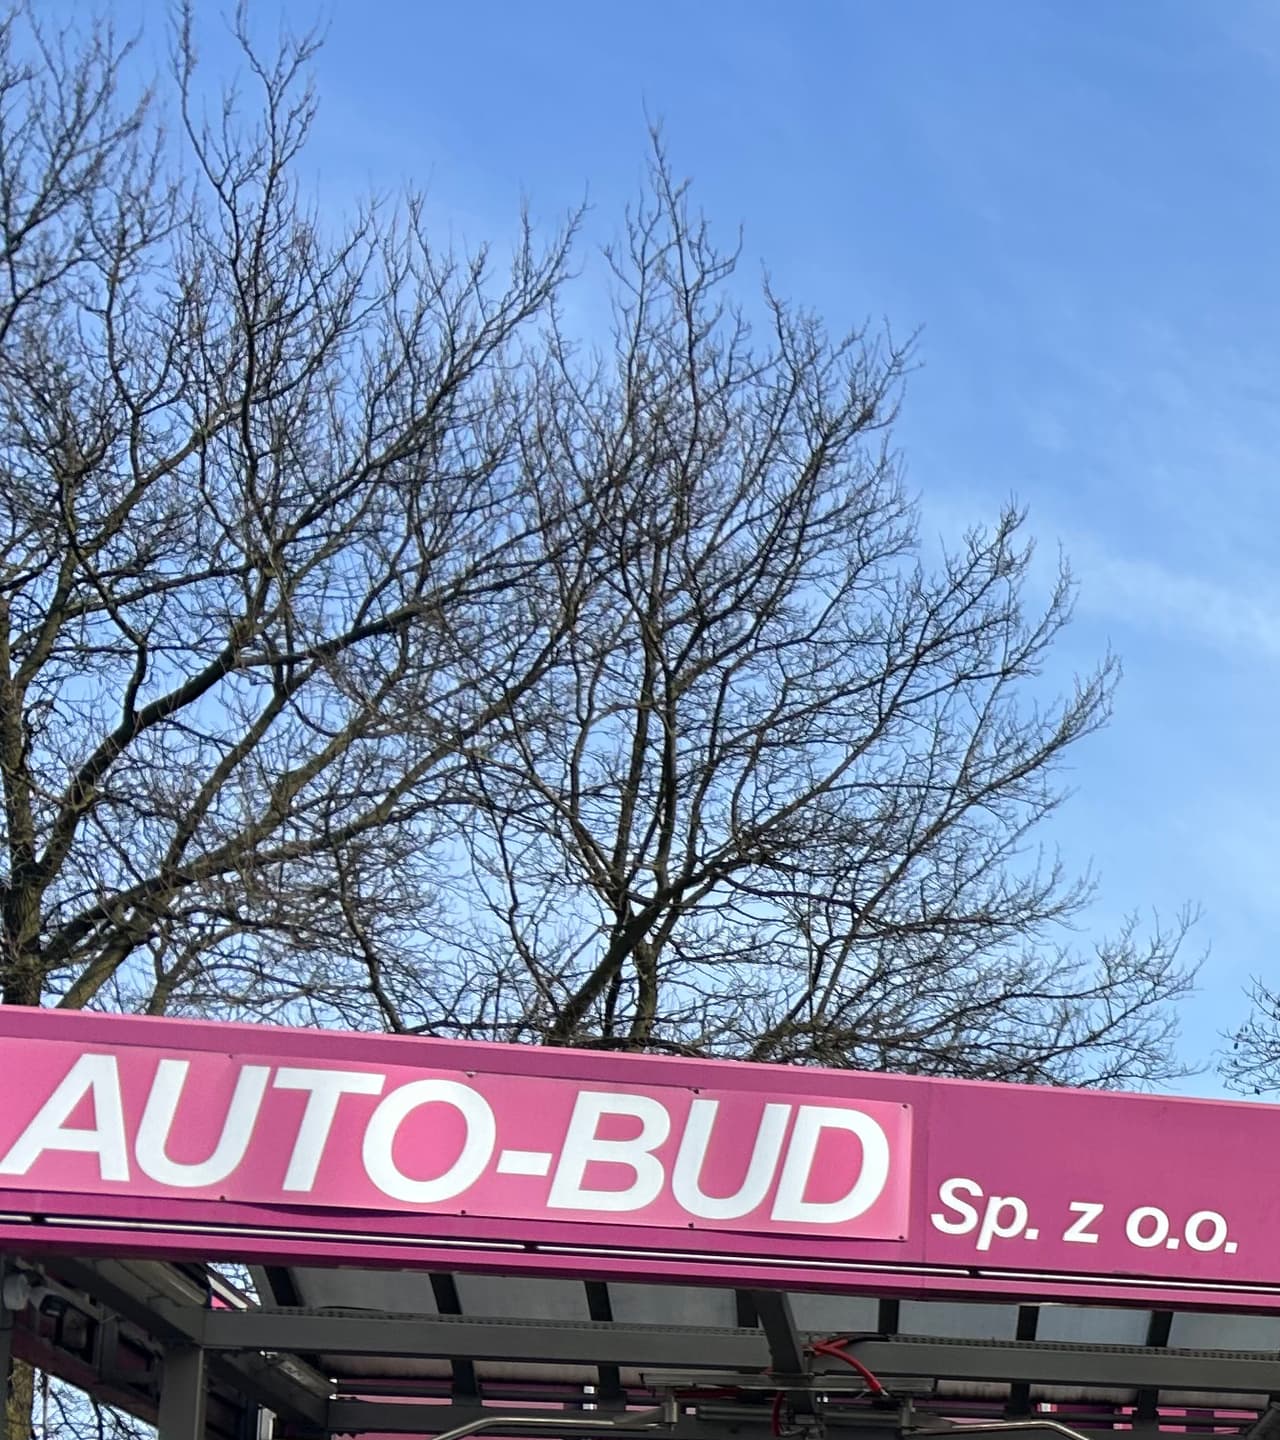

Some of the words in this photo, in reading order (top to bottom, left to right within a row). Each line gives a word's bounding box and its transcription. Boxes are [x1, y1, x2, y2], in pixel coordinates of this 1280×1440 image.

[1, 1054, 890, 1224] AUTO-BUD
[931, 1177, 1039, 1251] Sp.
[1062, 1201, 1104, 1243] z
[1125, 1206, 1239, 1254] o.o.
